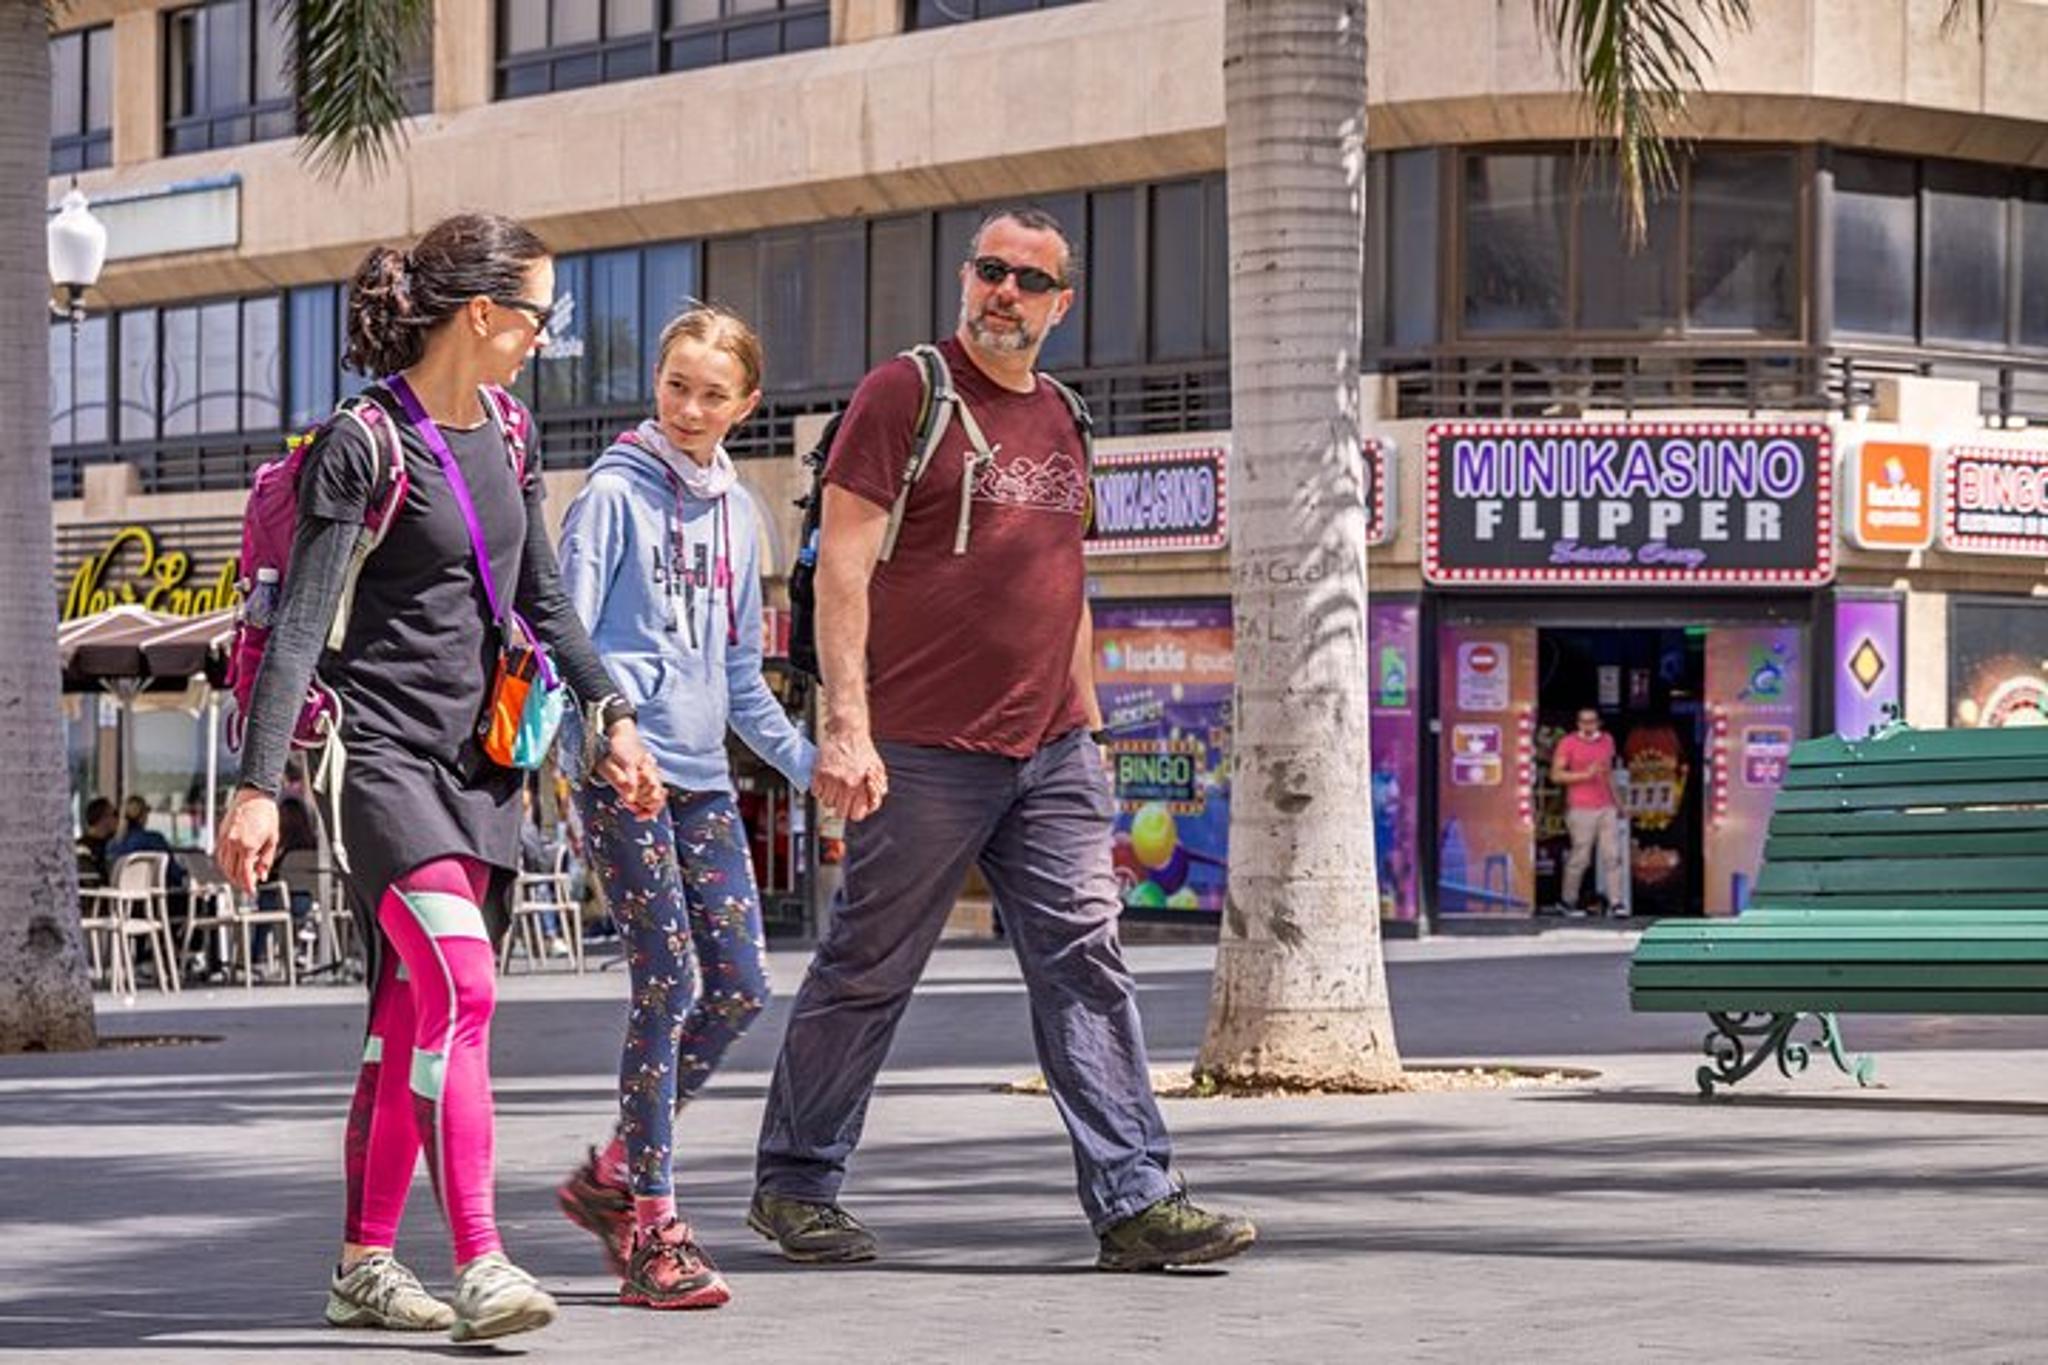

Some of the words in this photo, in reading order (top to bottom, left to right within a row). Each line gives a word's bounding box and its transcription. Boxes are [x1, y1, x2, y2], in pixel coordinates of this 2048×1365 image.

[1454, 439, 1803, 498] MINIKASINO
[1094, 466, 1215, 532] NIKASINO
[1475, 501, 1782, 540] FLIPPER
[1120, 755, 1190, 785] BINGO
